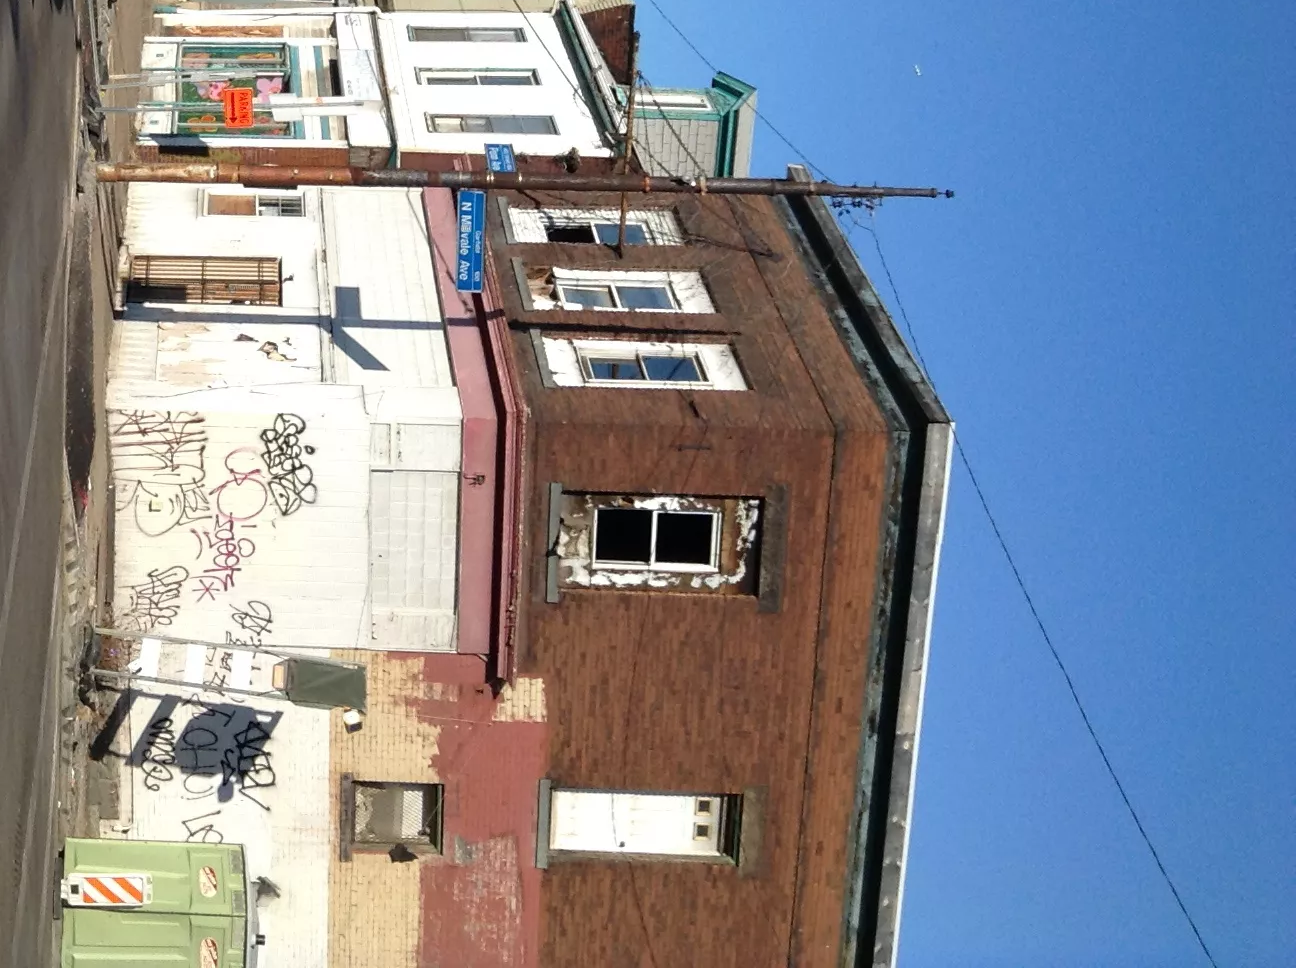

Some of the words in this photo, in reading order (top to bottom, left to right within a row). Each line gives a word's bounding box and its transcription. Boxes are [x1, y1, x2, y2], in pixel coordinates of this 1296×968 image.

[238, 92, 250, 124] PARKING
[461, 202, 472, 210] N
[459, 260, 470, 281] Ave
